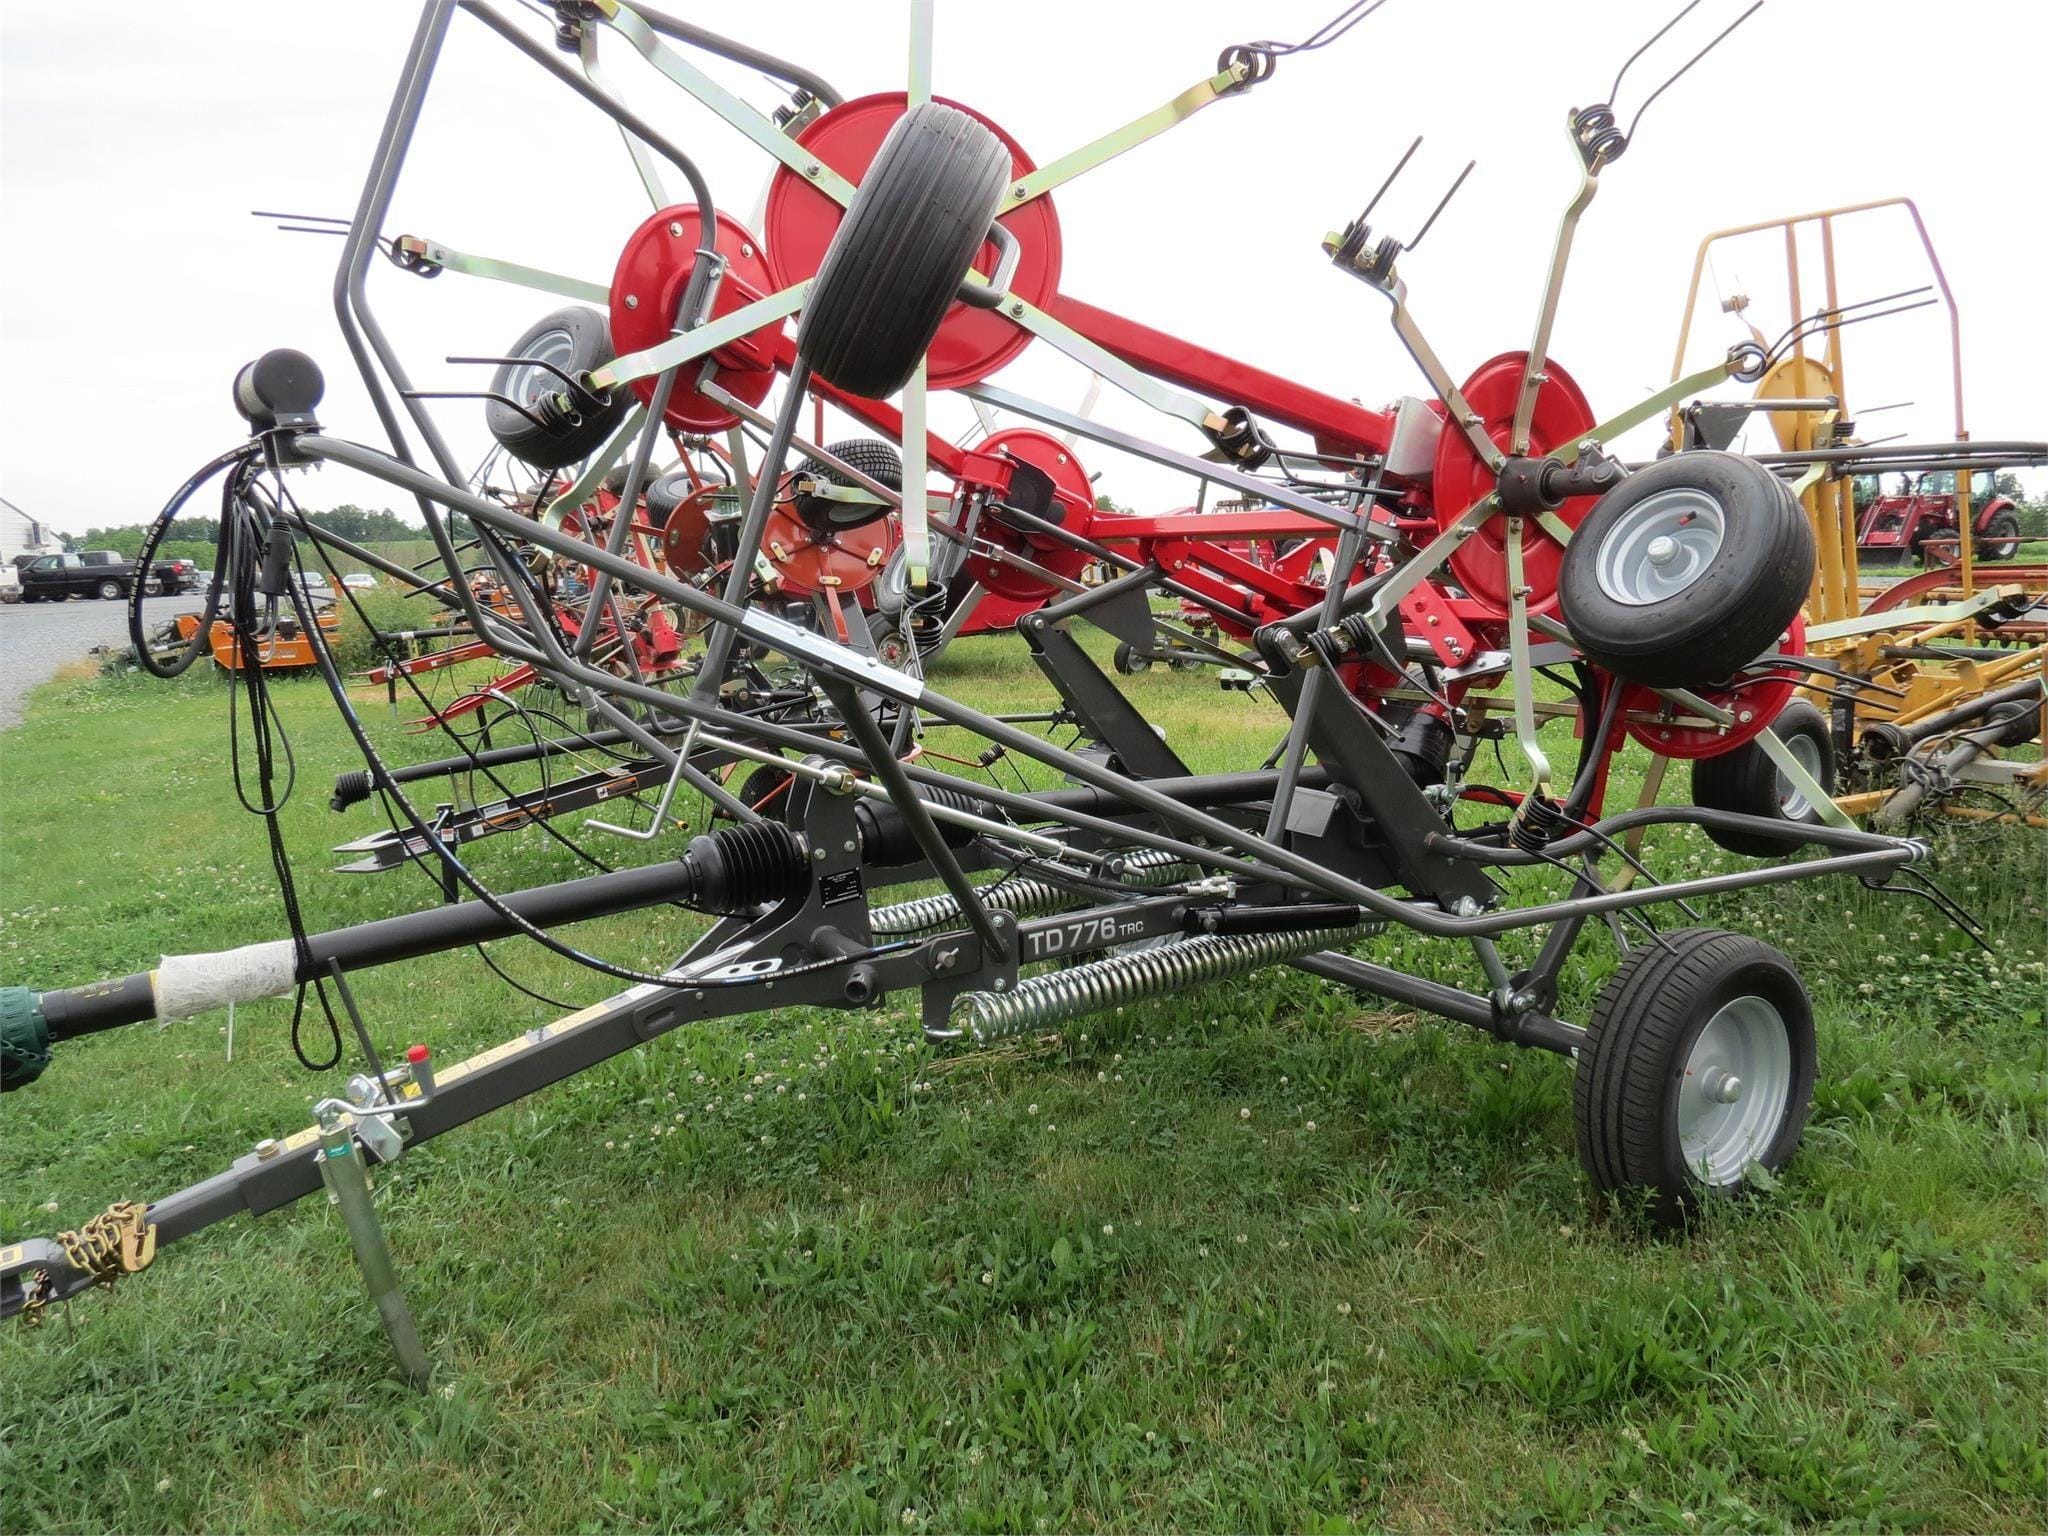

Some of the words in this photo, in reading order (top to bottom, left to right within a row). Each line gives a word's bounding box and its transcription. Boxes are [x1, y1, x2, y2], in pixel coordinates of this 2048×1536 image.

[1028, 928, 1064, 955] TD
[1067, 917, 1115, 948] 776
[1119, 921, 1144, 936] TRC
